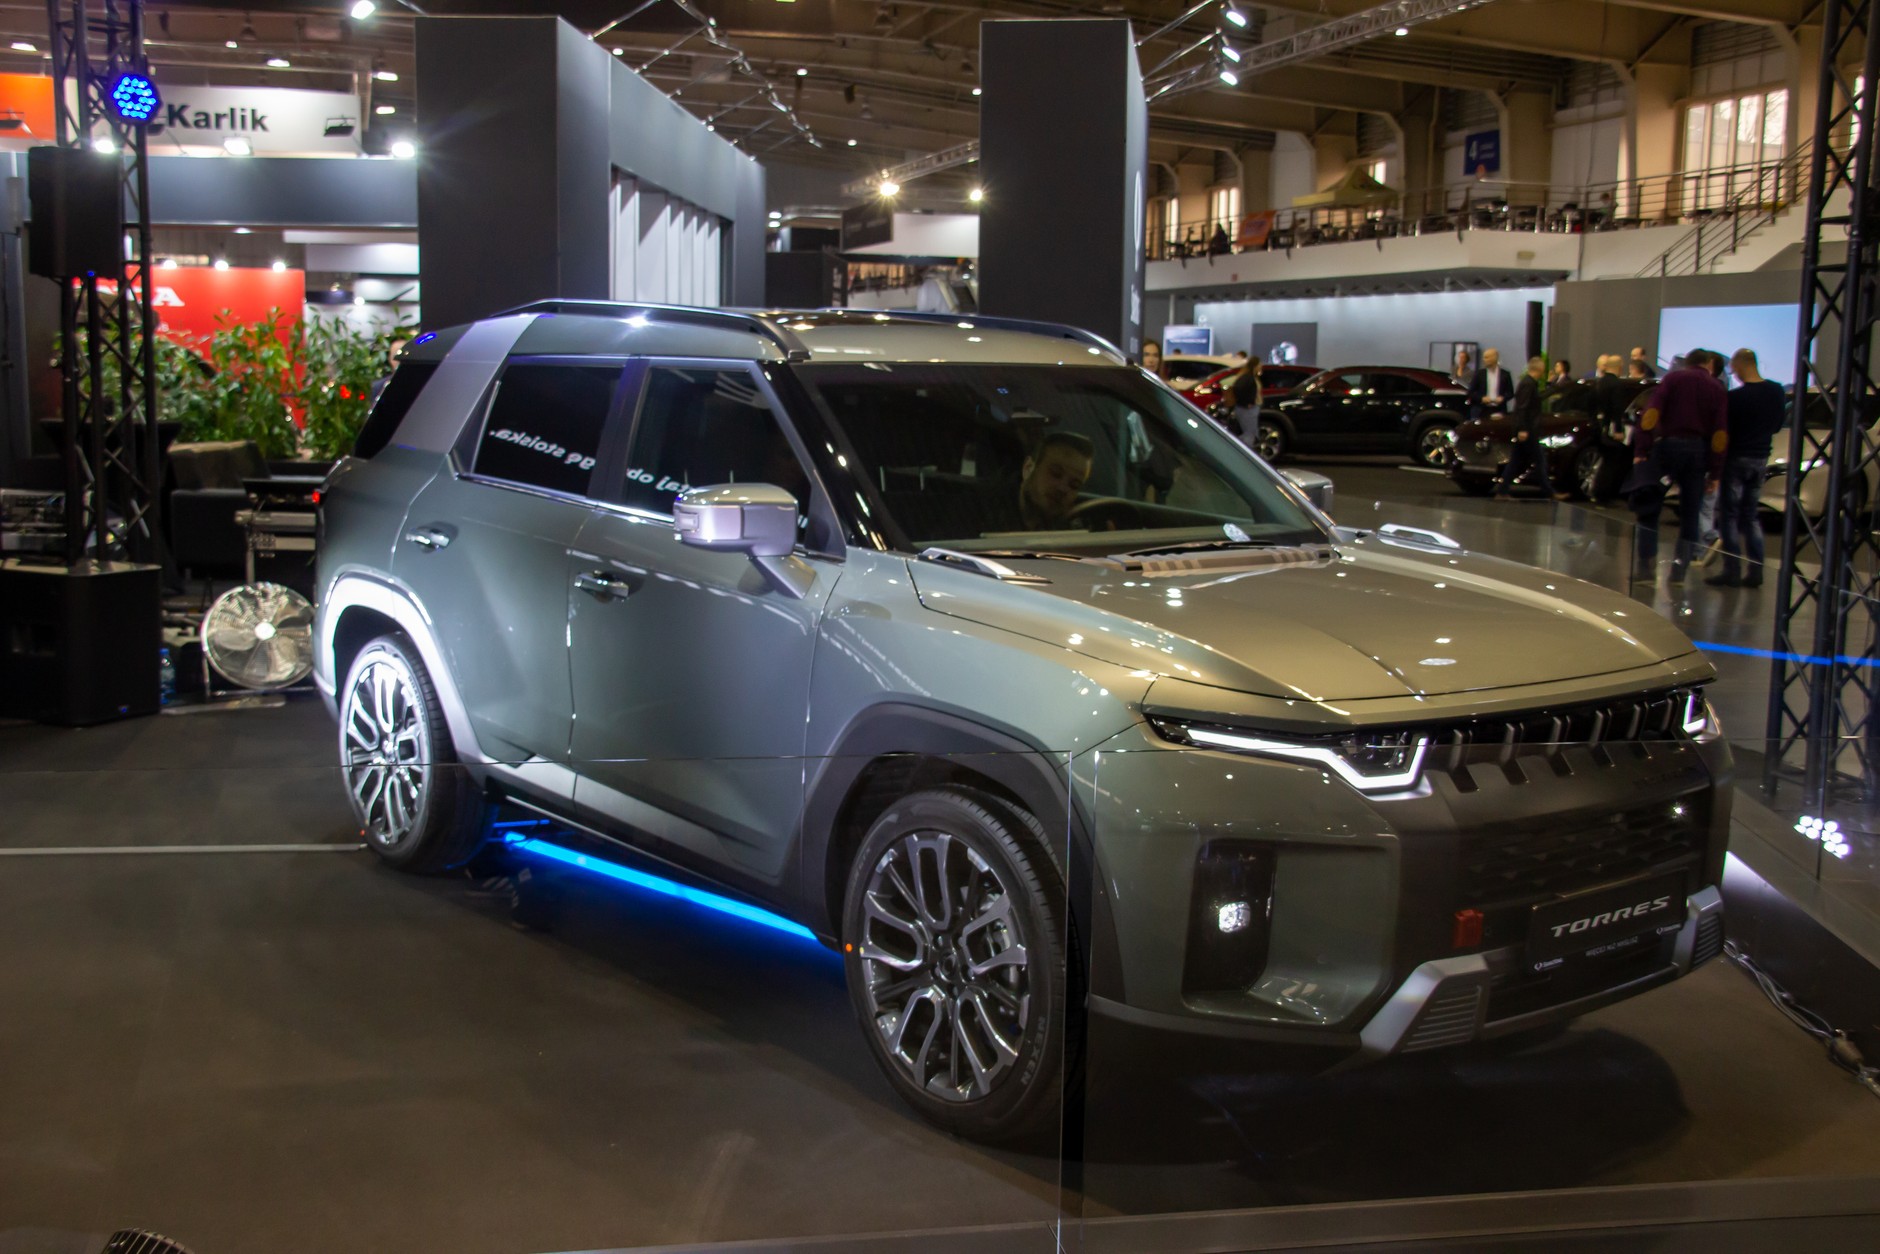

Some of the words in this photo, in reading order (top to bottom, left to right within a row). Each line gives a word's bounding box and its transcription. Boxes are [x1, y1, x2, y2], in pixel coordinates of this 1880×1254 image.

[167, 104, 269, 132] Karlik
[1469, 140, 1478, 161] 4
[1551, 896, 1670, 937] TORRES
[1020, 1016, 1046, 1086] NEXEN
